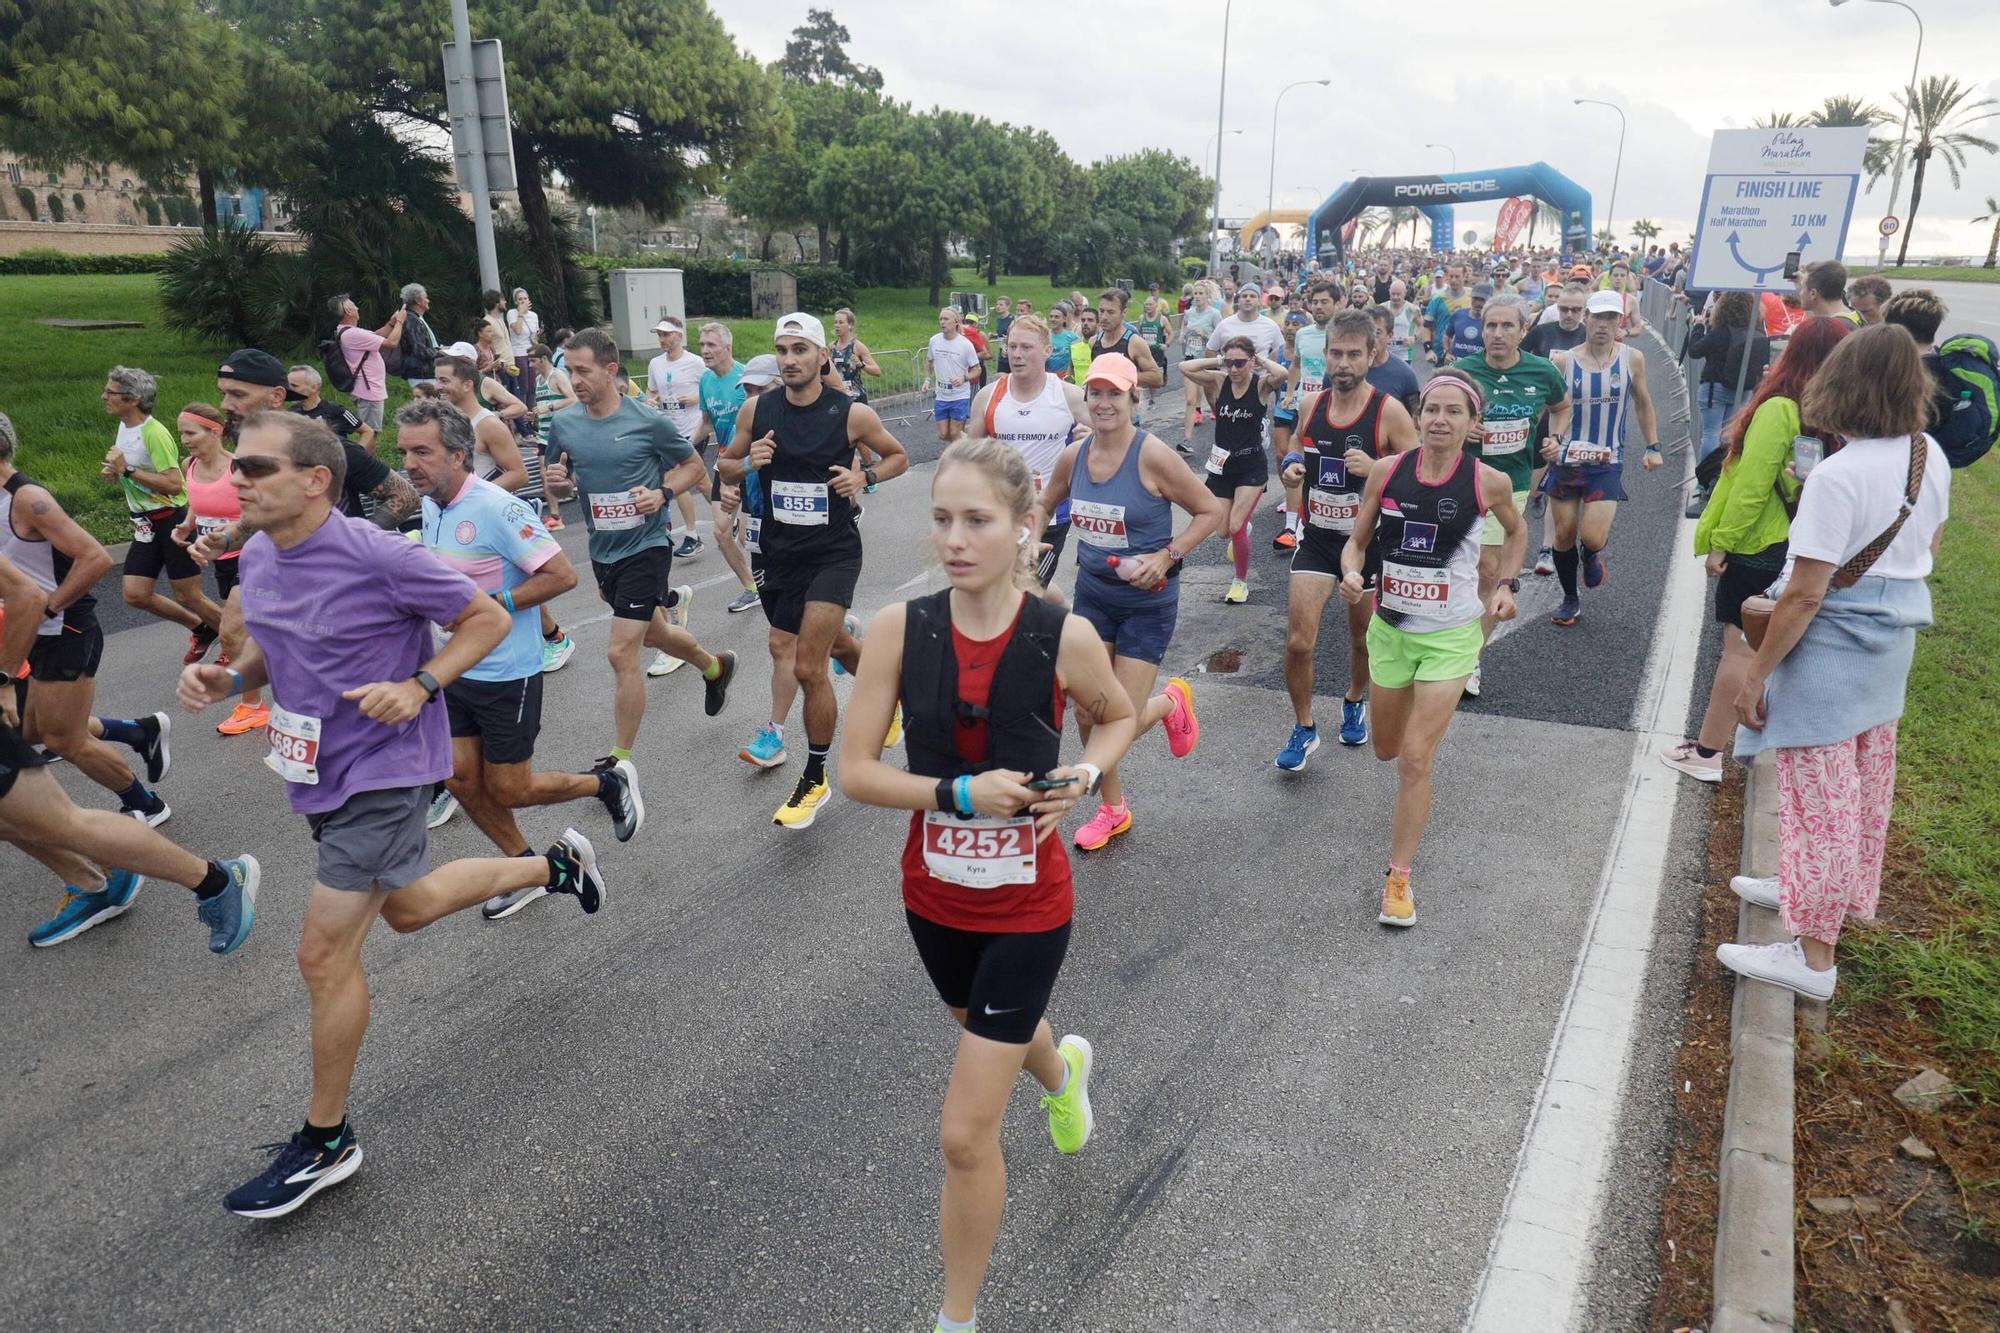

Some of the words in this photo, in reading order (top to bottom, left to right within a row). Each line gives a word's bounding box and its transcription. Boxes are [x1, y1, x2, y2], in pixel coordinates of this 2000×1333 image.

[1771, 132, 1804, 146] Palma
[1760, 145, 1811, 159] Marathon
[1394, 179, 1497, 197] POWERADE
[1736, 181, 1787, 198] FINISH
[1788, 181, 1823, 198] LINE
[1721, 206, 1760, 217] Marathon
[1710, 217, 1728, 228] Half
[1729, 217, 1767, 227] Marathon
[1791, 214, 1806, 227] 10
[1808, 214, 1827, 227] KM
[1017, 433, 1047, 441] FERMOY
[1489, 430, 1524, 444] 4096
[1319, 471, 1340, 484] AXA
[782, 496, 815, 511] 855
[1313, 502, 1353, 519] 3089
[598, 504, 636, 518] 2529
[1077, 515, 1117, 534] 2707
[1408, 536, 1428, 549] AXA
[1389, 579, 1440, 600] 3090
[936, 827, 1020, 857] 4252
[966, 865, 987, 875] Kyra
